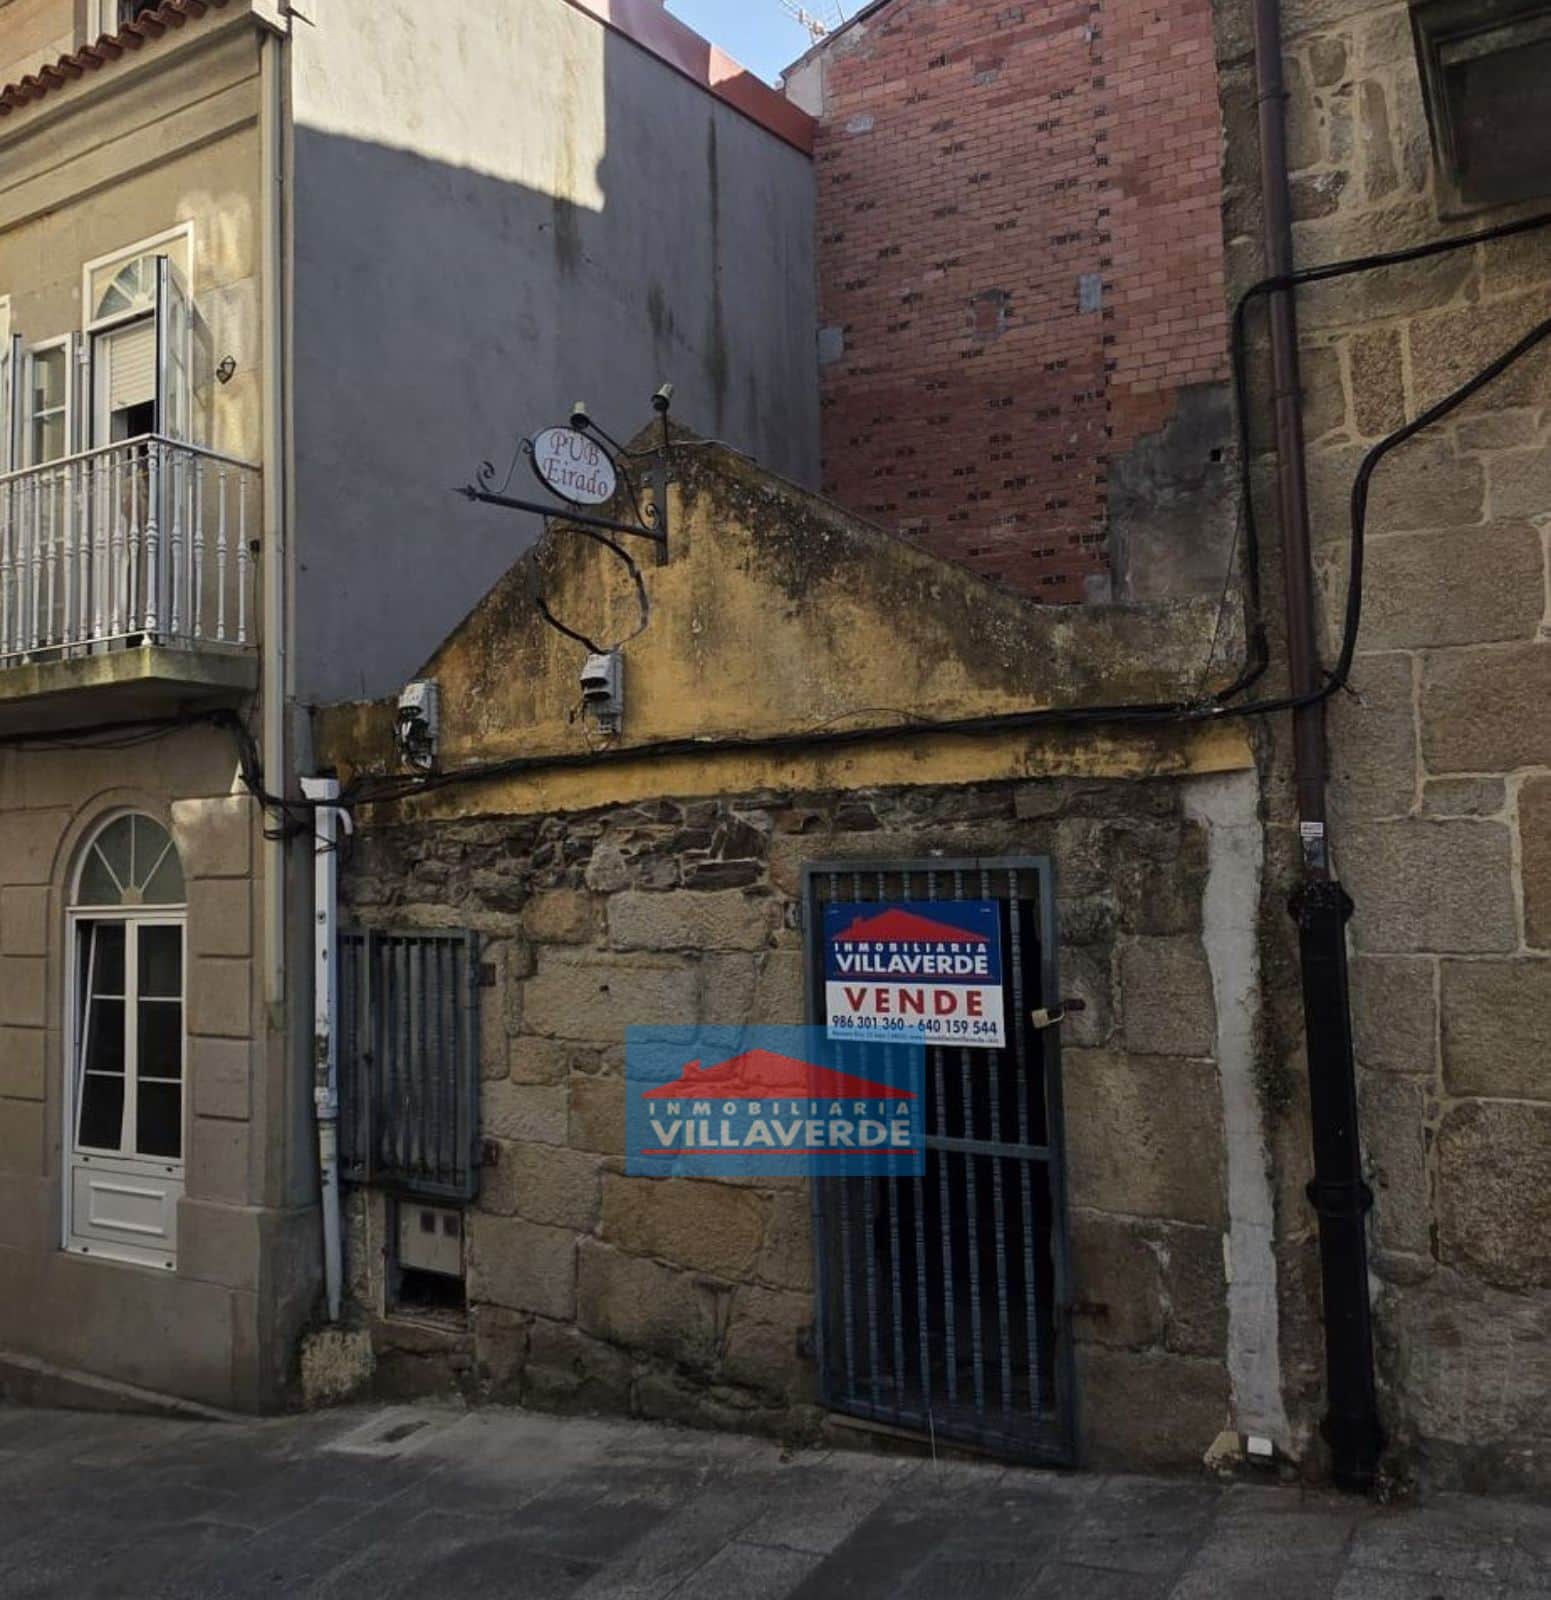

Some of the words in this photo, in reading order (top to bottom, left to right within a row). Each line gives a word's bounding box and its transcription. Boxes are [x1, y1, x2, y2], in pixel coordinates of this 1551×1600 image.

[550, 432, 599, 466] PUB
[544, 458, 608, 497] Eirado
[835, 943, 987, 953] INMOBILIARIA
[835, 954, 988, 974] VILLAVERDE
[844, 987, 983, 1016] VENDE
[832, 1015, 854, 1029] 986
[857, 1016, 877, 1030] 301
[882, 1017, 904, 1031] 360
[918, 1019, 941, 1033] 640
[946, 1020, 968, 1034] 159
[973, 1021, 997, 1036] 544
